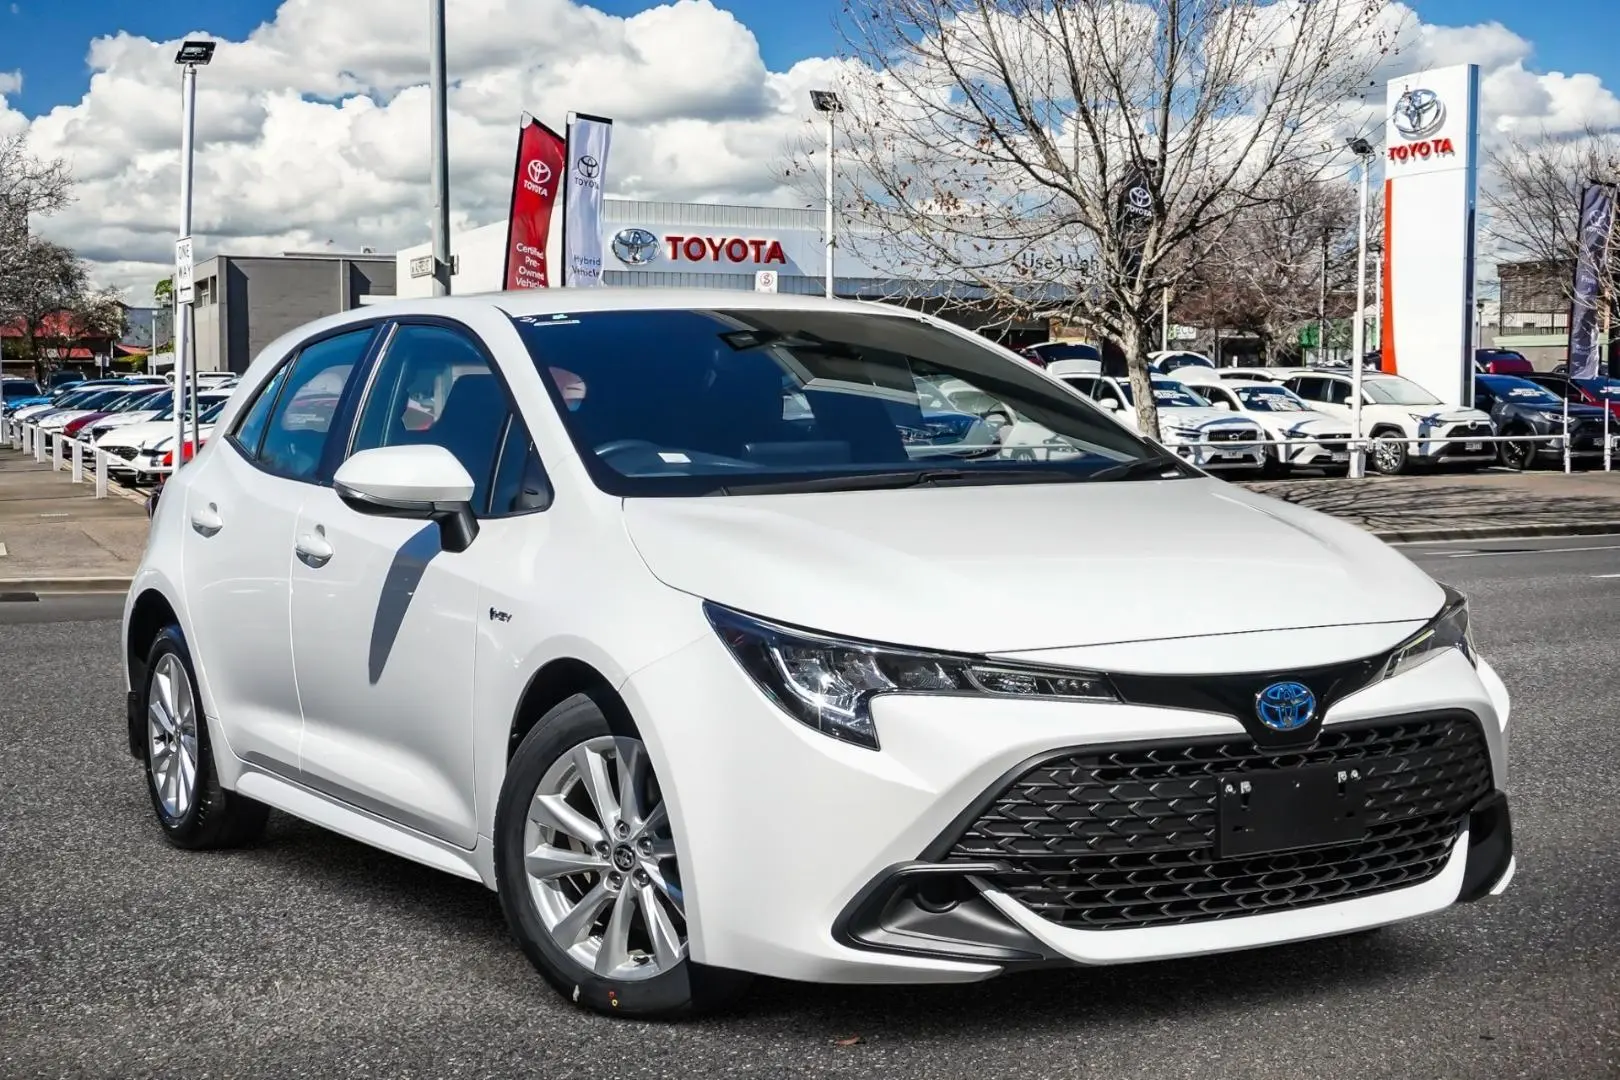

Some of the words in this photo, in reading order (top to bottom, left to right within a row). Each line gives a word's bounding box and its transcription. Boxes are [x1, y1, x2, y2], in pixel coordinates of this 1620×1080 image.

[1388, 138, 1454, 161] TOYOTA
[523, 180, 548, 197] TOYOTA
[573, 254, 601, 265] Hybrid
[665, 236, 786, 264] TOYOTA
